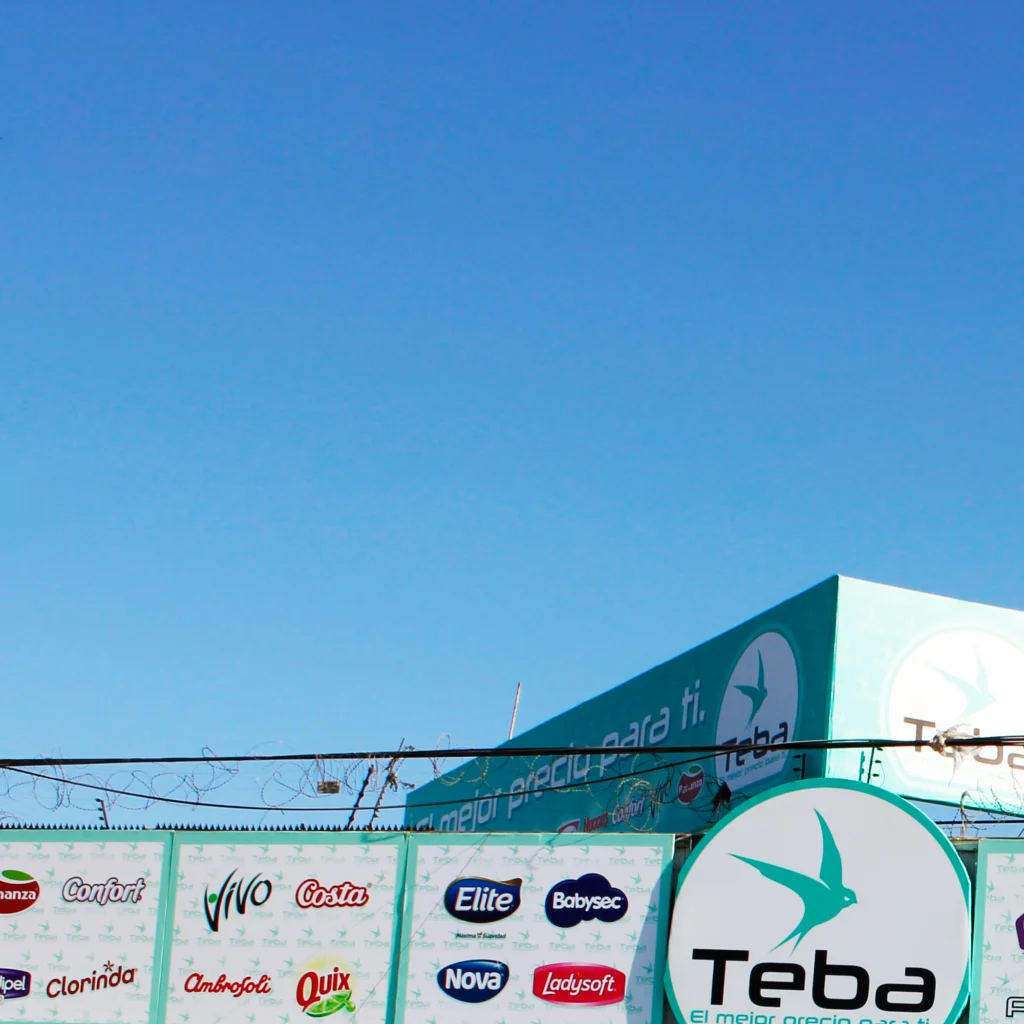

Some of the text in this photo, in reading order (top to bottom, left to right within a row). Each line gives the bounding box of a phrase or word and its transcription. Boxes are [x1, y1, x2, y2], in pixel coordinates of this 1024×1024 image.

[507, 742, 591, 819] precio
[601, 706, 671, 777] para
[682, 680, 705, 730] ti.
[722, 722, 788, 772] Teba
[62, 876, 146, 906] Confort
[295, 878, 369, 909] Costa
[454, 886, 514, 912] Elite
[552, 892, 622, 912] Babysec
[47, 965, 136, 998] Clorinda
[296, 967, 351, 1012] Quix
[445, 968, 502, 990] Nova
[542, 972, 615, 996] Ladysoft
[691, 948, 936, 1013] Teba
[690, 1009, 708, 1024] El
